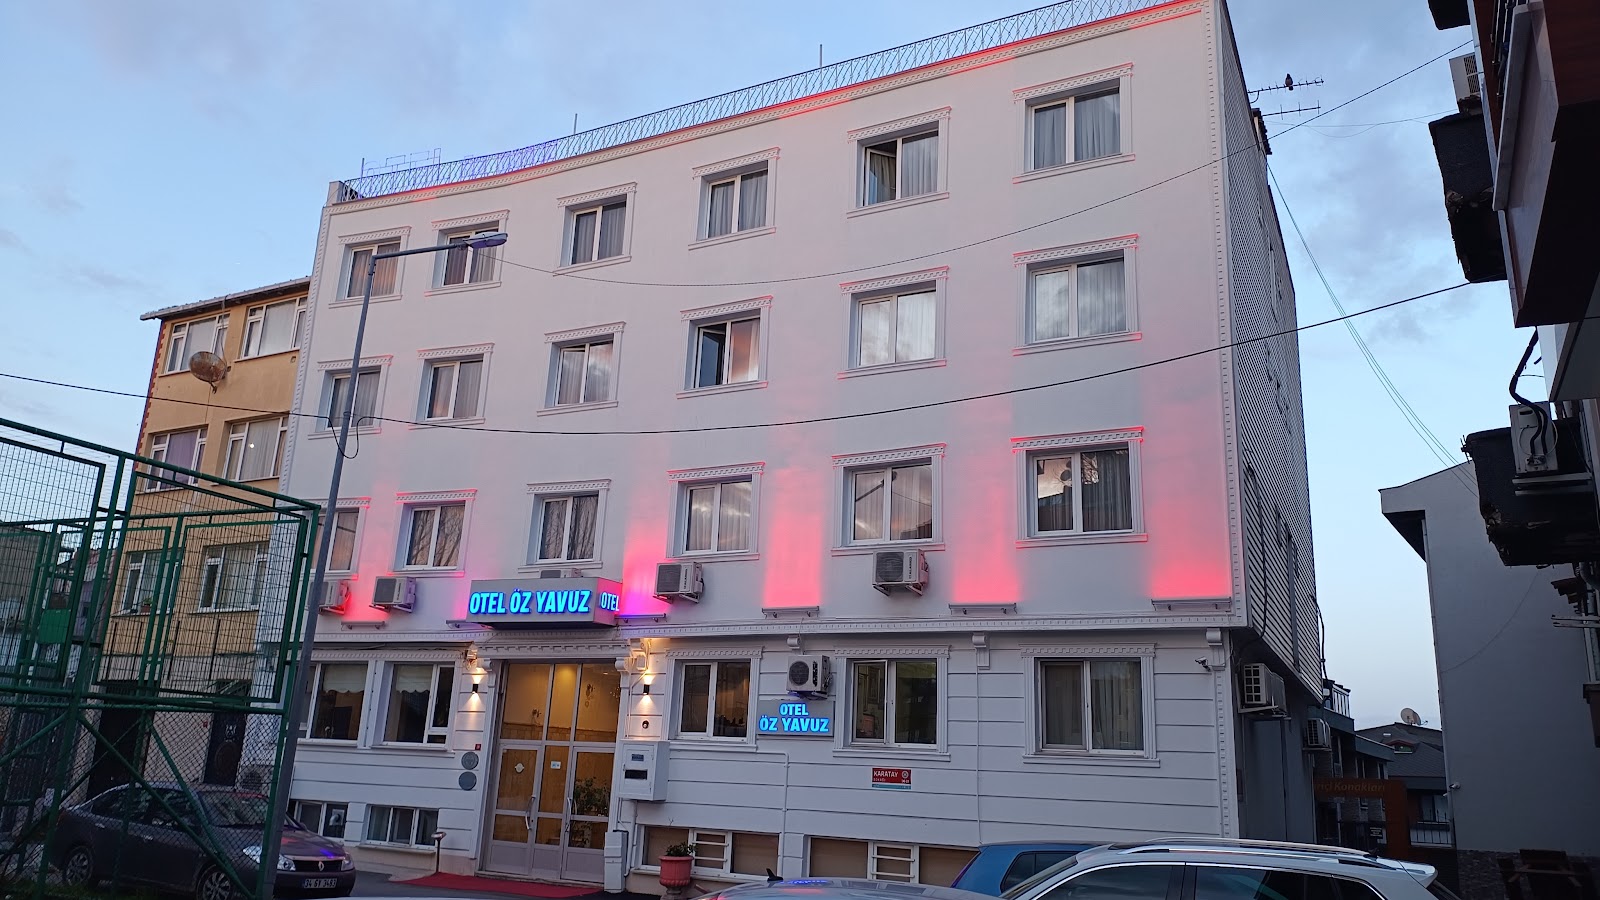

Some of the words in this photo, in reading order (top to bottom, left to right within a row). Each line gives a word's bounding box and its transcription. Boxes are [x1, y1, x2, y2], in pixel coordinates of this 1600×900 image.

[469, 592, 506, 613] OTEL
[509, 588, 532, 613] ÖZ
[536, 590, 591, 613] YAVUZ
[600, 591, 619, 611] OTEL
[779, 703, 808, 715] OTEL
[759, 715, 778, 731] ÖZ
[781, 717, 829, 732] YAVUZ
